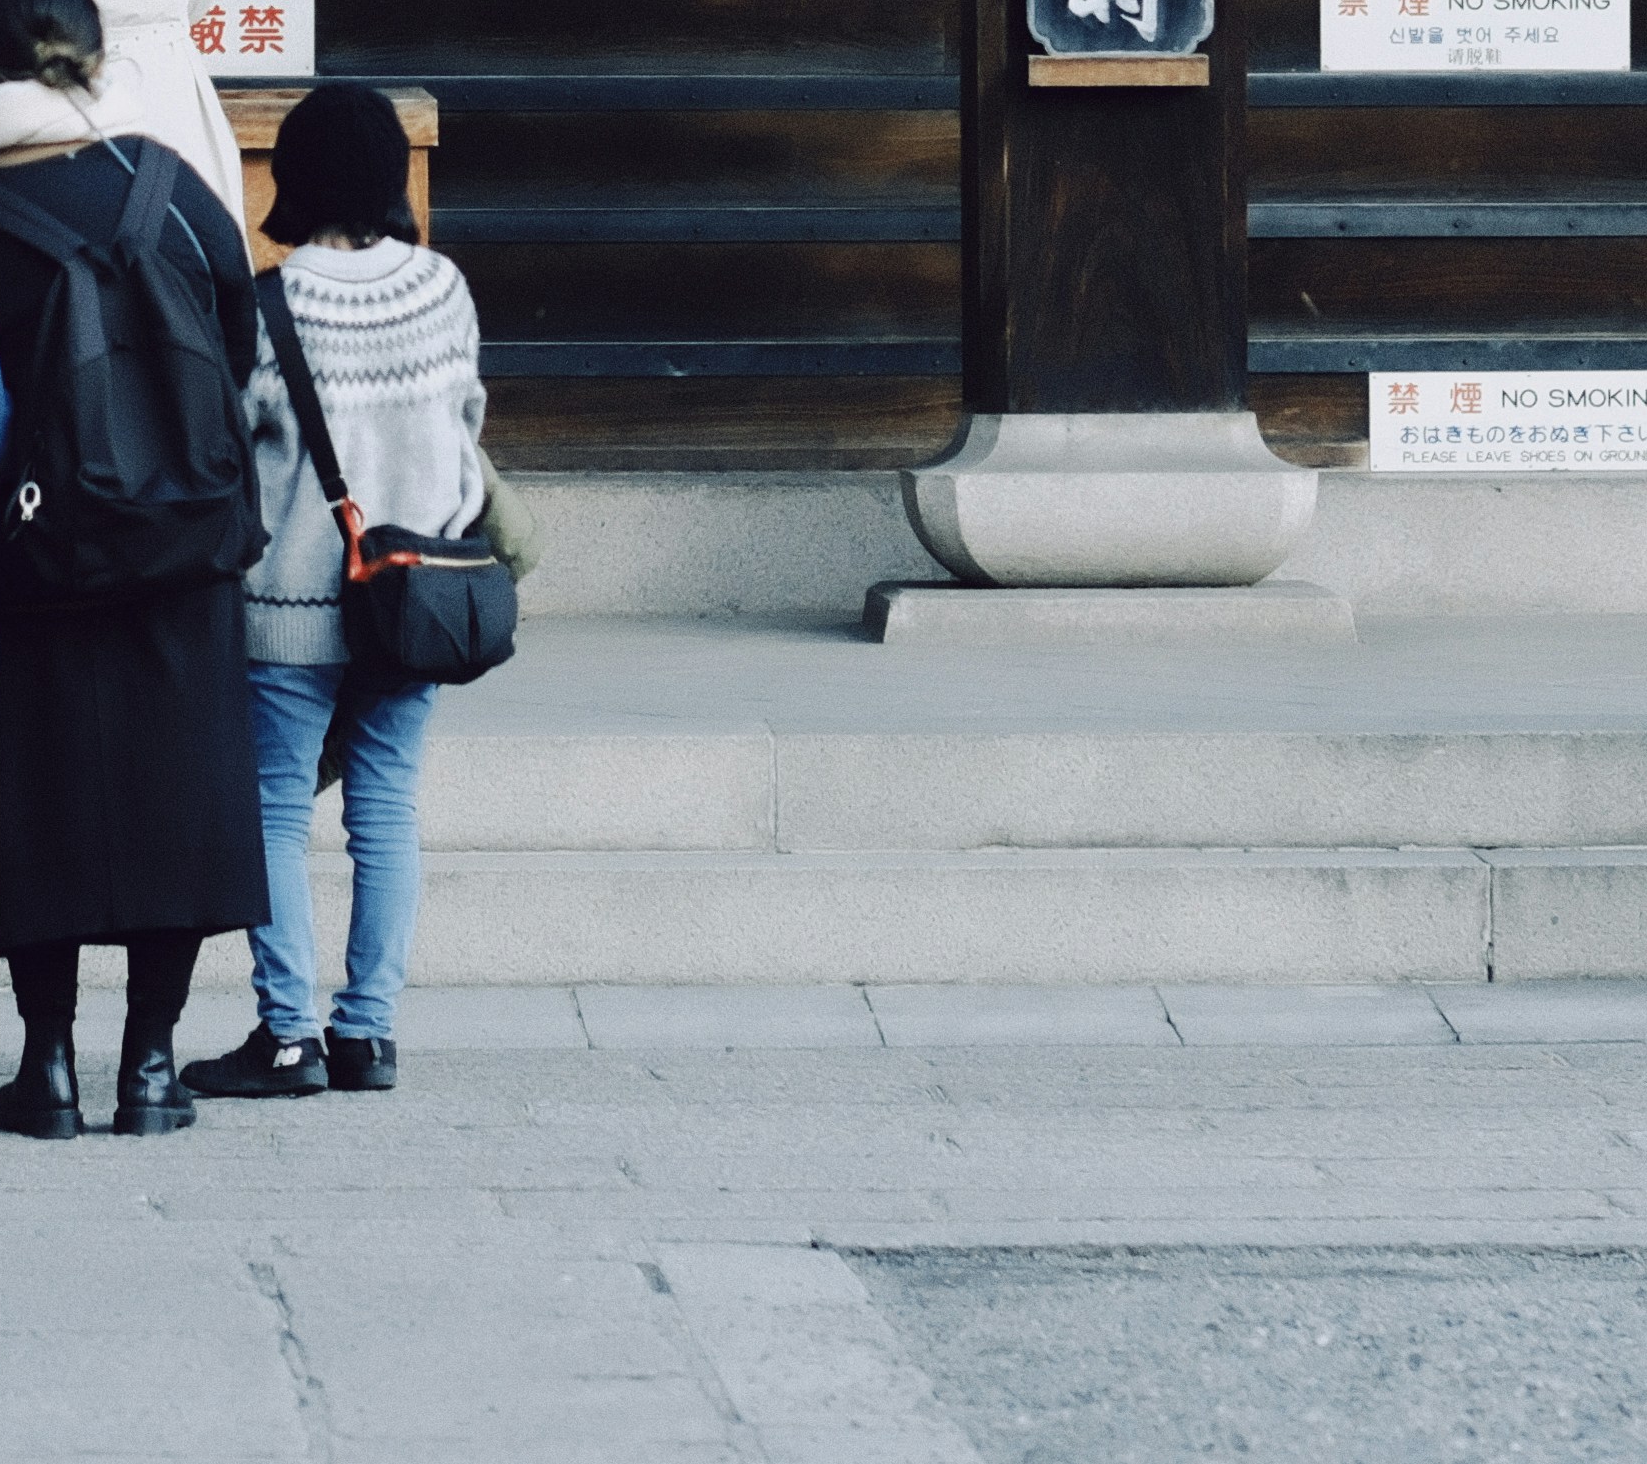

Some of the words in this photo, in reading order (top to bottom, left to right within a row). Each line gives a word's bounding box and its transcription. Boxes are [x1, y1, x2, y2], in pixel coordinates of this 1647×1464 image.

[190, 5, 286, 55] 厳禁
[1389, 26, 1444, 45] 신발을
[1456, 26, 1492, 44] 벗어
[1504, 26, 1559, 44] 주세요
[1501, 388, 1539, 408] NO
[1402, 451, 1458, 464] PLEASE
[1466, 451, 1511, 464] LEAVE
[1520, 450, 1566, 463] SHOES
[1574, 450, 1594, 463] ON
